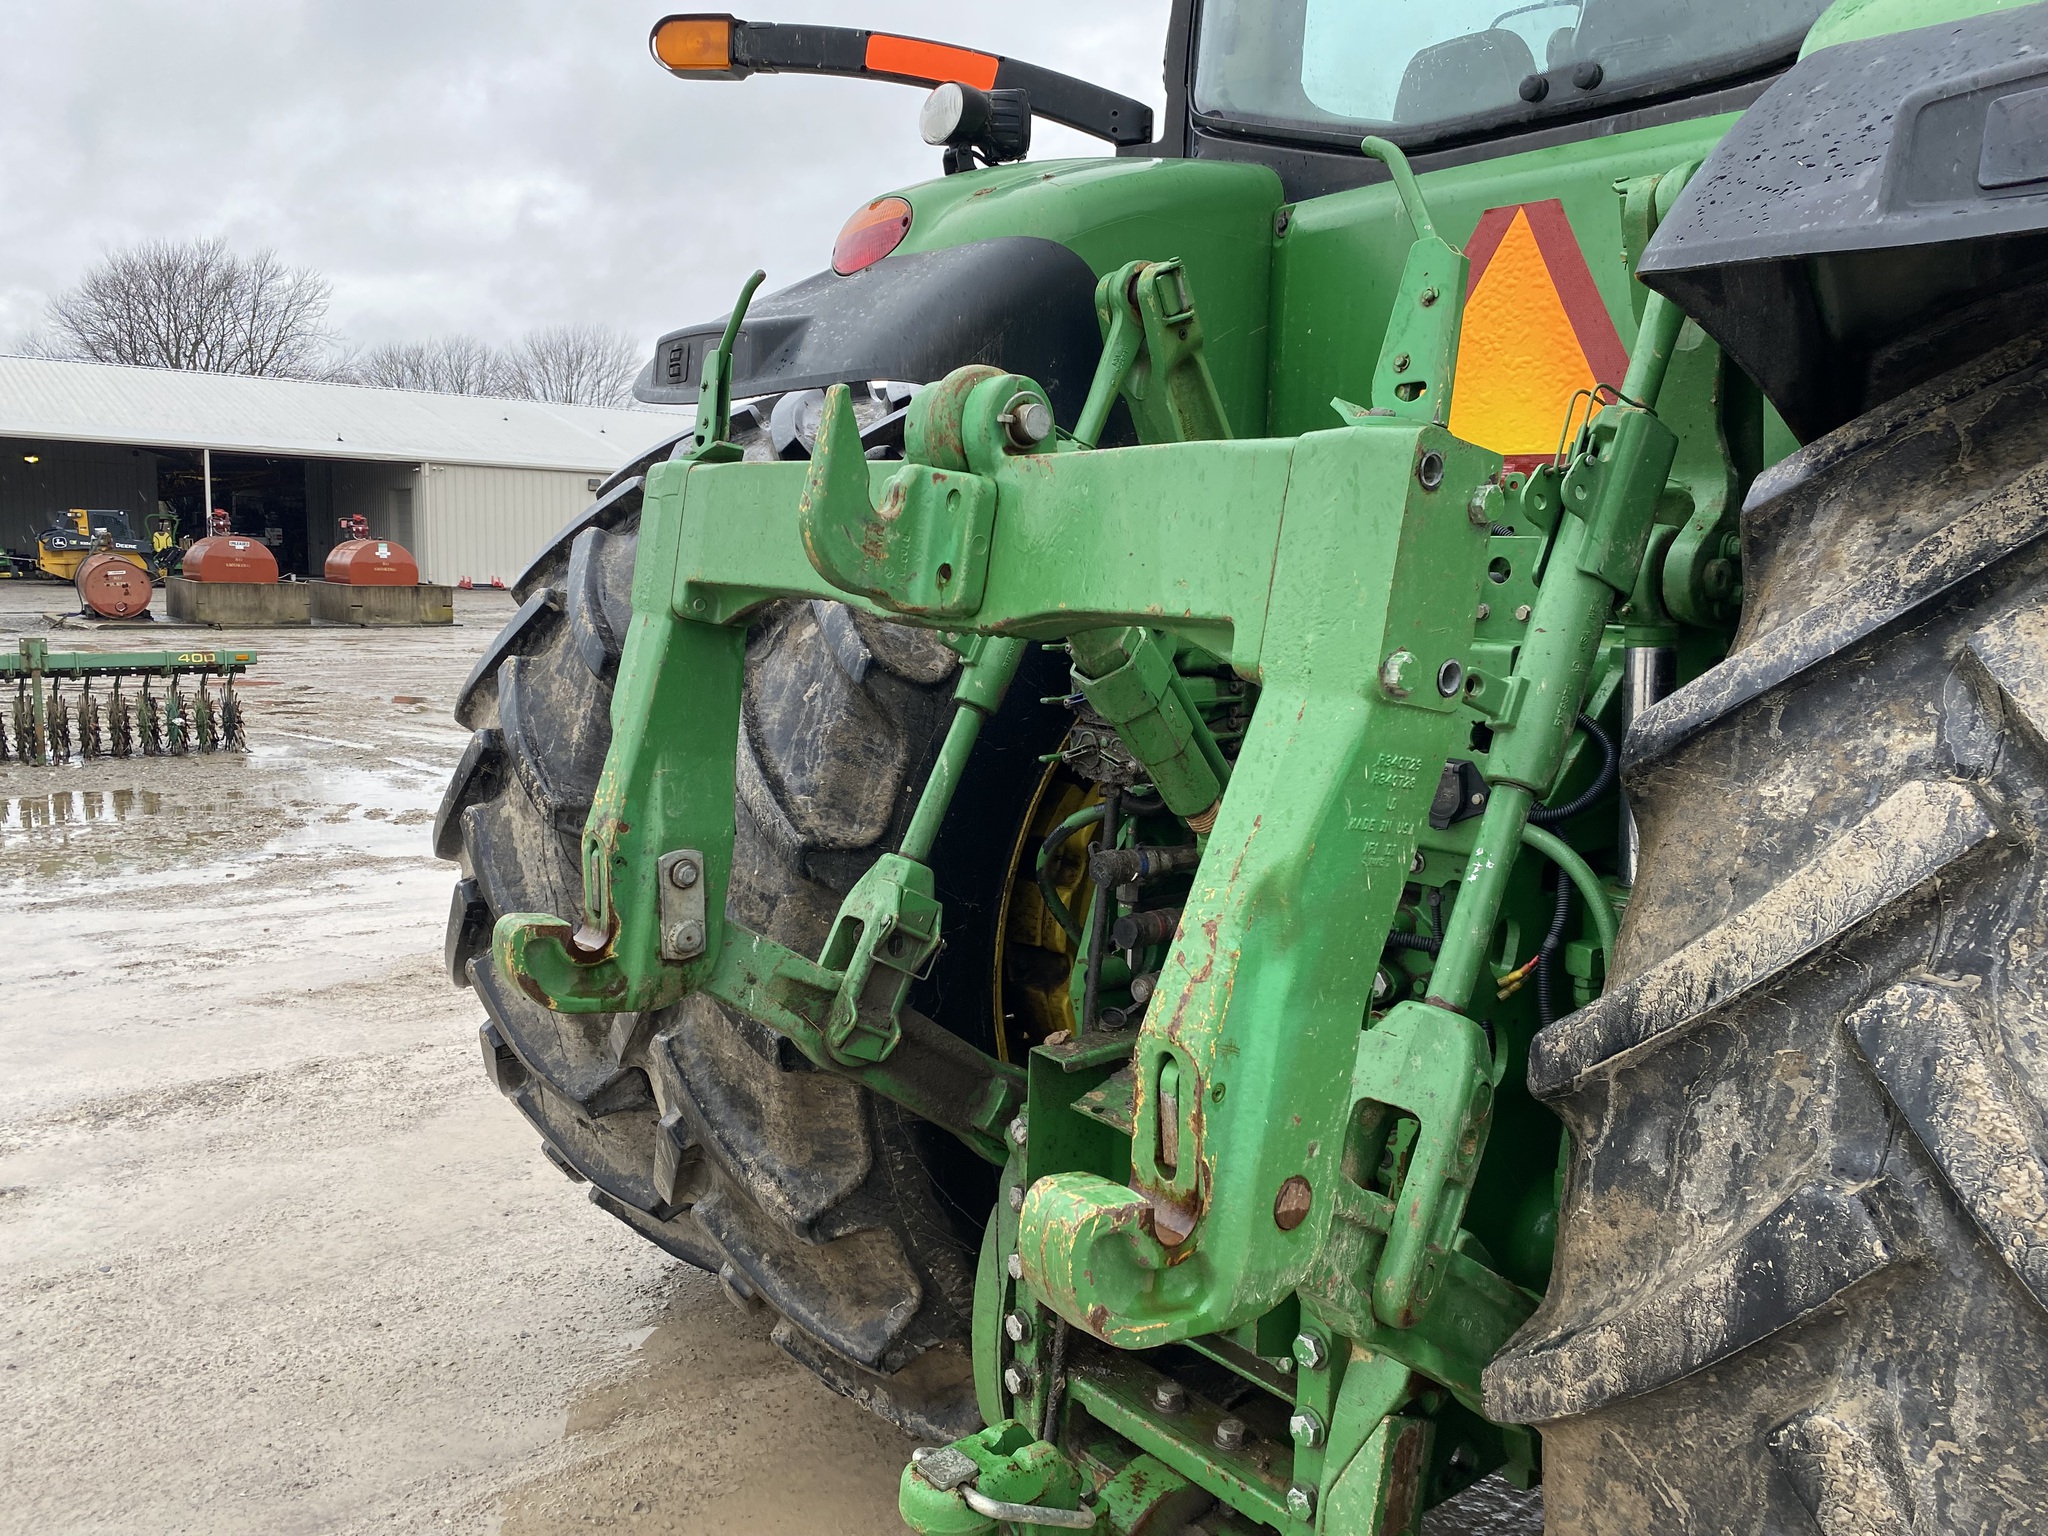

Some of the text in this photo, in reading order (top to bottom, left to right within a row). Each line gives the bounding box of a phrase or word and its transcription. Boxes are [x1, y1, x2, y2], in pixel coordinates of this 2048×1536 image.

[115, 542, 138, 550] DEERE
[178, 653, 216, 663] 400
[1347, 817, 1376, 832] MADE
[1397, 821, 1415, 835] USA
